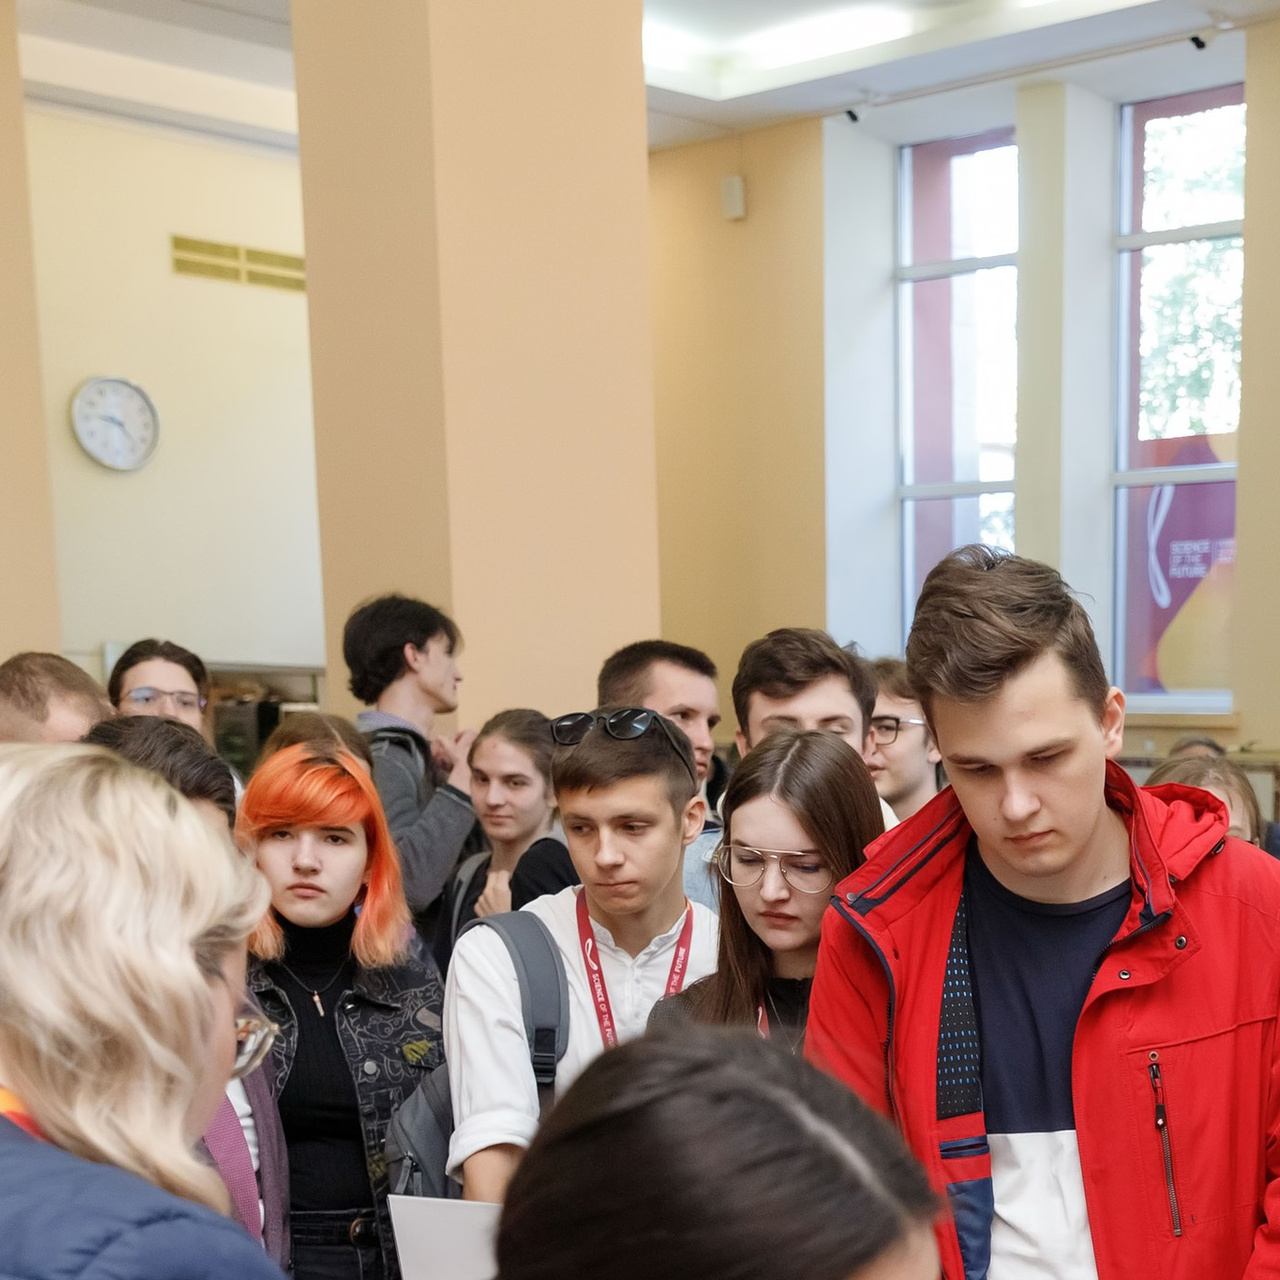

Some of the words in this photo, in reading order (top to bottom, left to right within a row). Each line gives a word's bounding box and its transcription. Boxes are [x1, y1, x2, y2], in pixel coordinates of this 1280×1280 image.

[675, 947, 686, 973] FUTURE
[671, 973, 680, 986] THE
[592, 973, 604, 1002] SCIENCE
[599, 1003, 607, 1013] OF
[602, 1014, 610, 1027] THE
